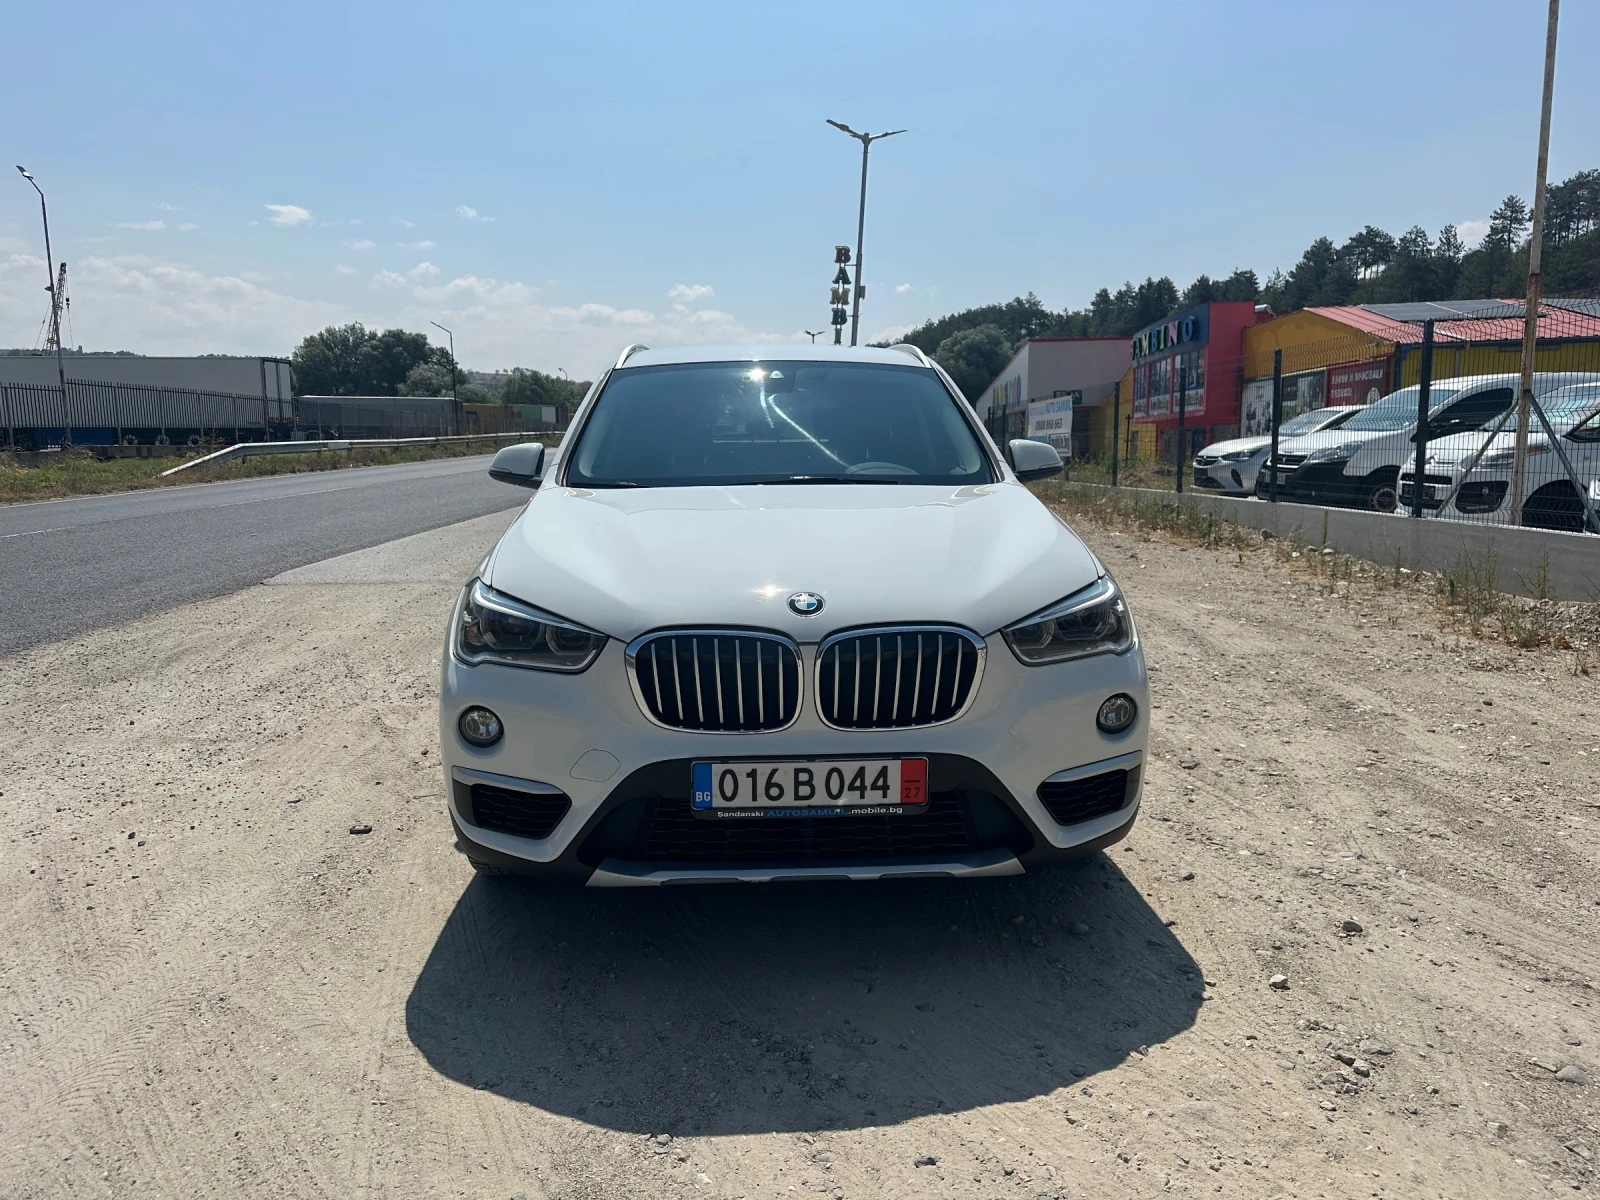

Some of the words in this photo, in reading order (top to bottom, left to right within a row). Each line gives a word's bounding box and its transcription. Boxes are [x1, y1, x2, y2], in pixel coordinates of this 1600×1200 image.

[1130, 315, 1195, 361] AMBINO
[695, 791, 711, 802] BG
[904, 786, 920, 798] 27
[717, 810, 764, 818] Sandanski
